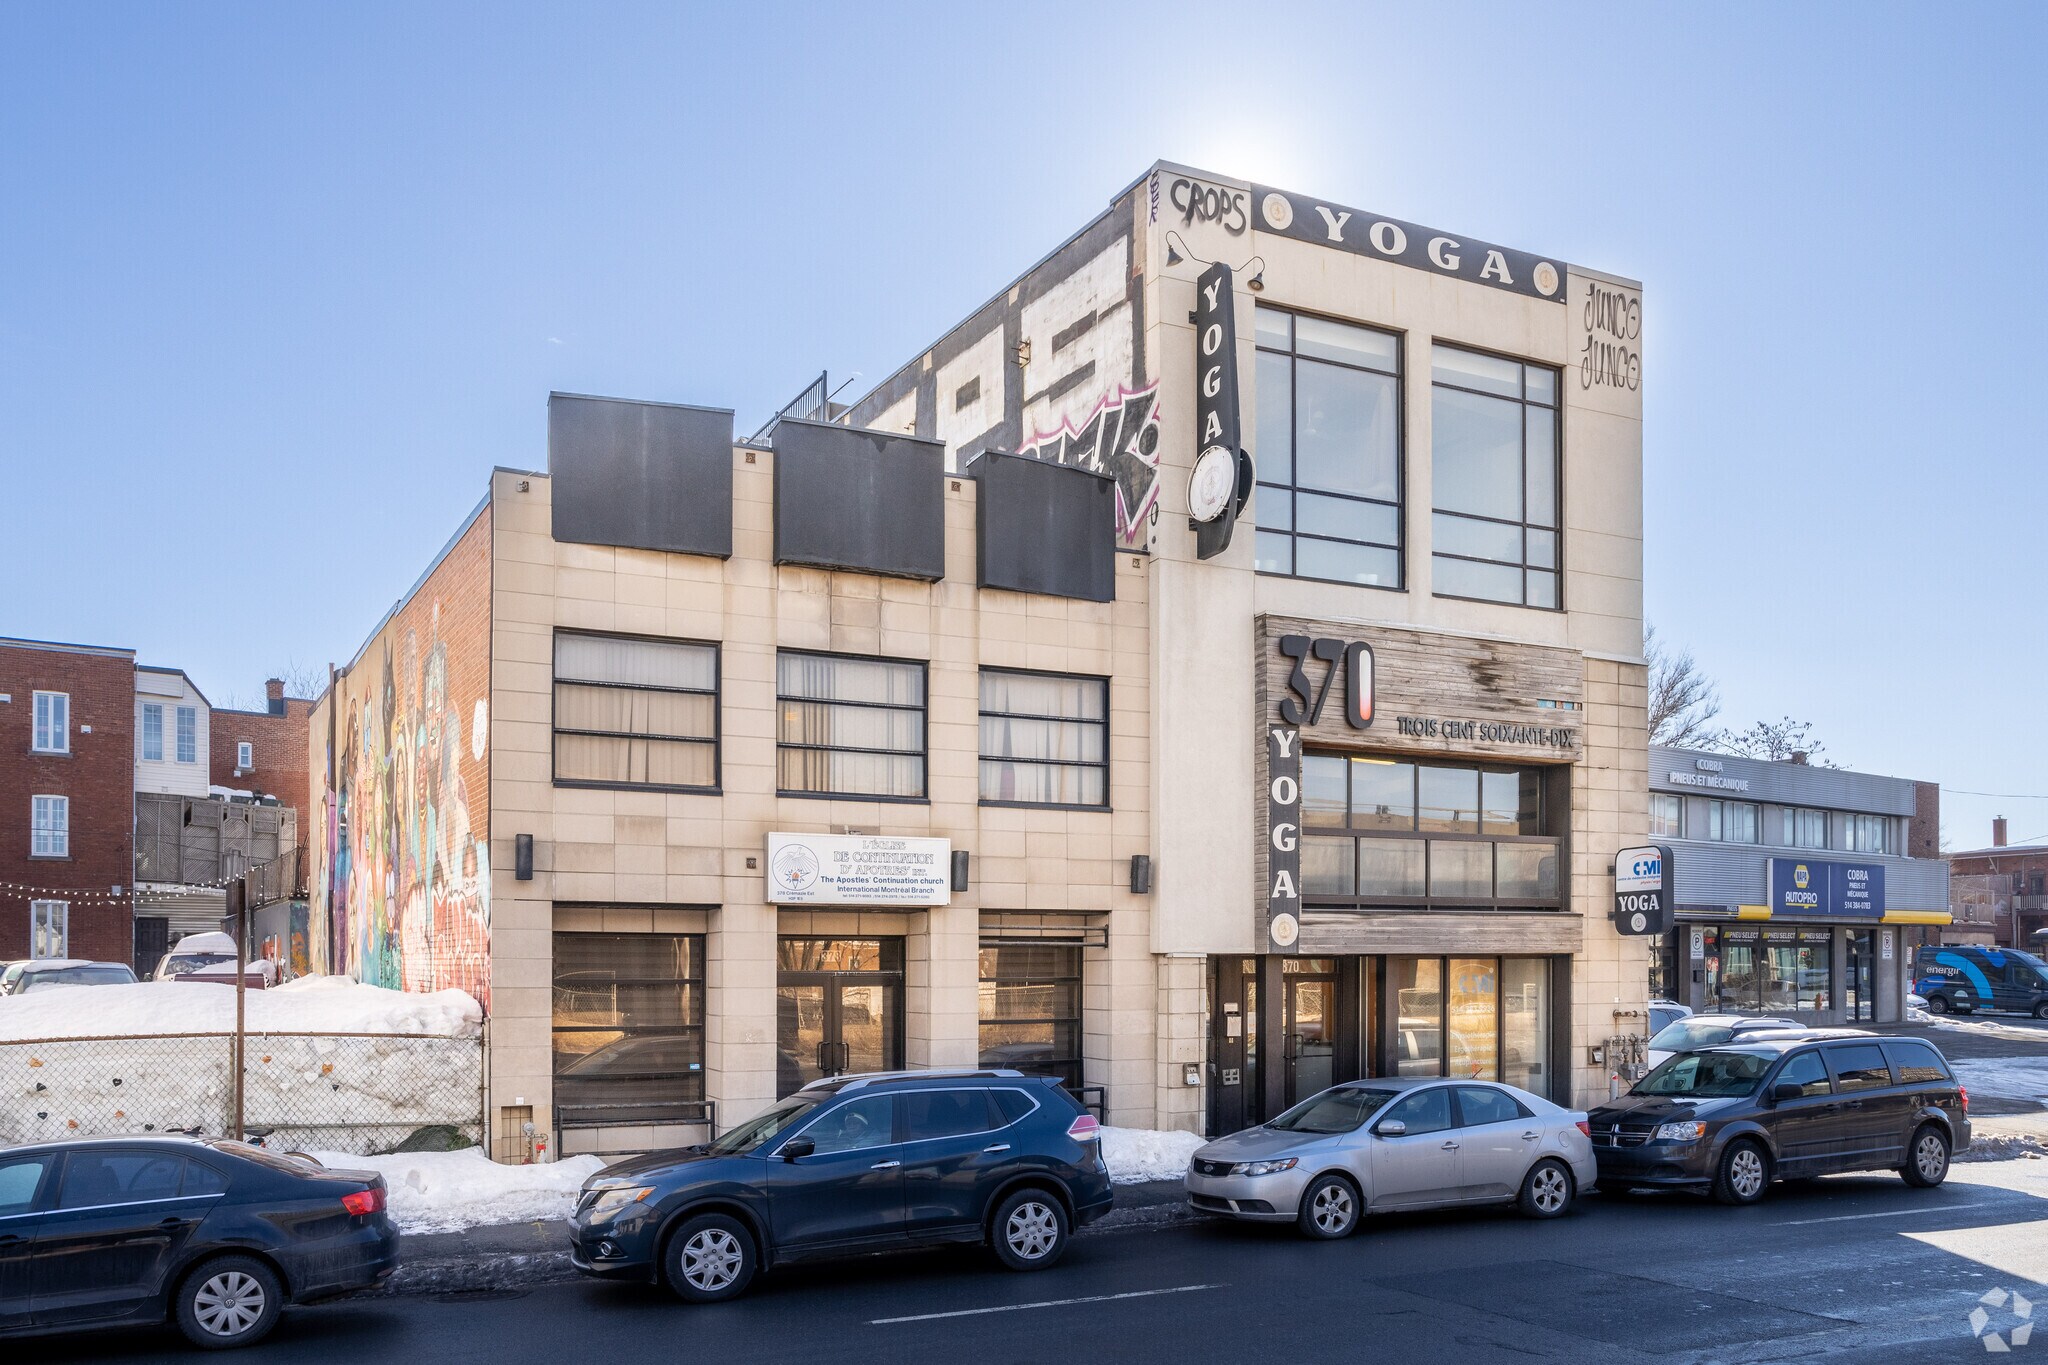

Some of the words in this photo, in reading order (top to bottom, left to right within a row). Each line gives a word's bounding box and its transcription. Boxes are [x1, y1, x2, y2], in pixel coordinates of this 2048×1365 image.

[1170, 179, 1247, 237] CROPS
[1315, 206, 1514, 285] YOGA
[1584, 283, 1641, 339] JUNCO
[1203, 277, 1223, 444] YOGA
[1581, 334, 1640, 391] JUNCO
[1280, 634, 1375, 729] 370
[1397, 716, 1438, 738] TROIS
[1441, 720, 1476, 740] CENT
[1480, 722, 1573, 748] SOIXANTE-DIX
[1696, 760, 1723, 772] COBRA
[1669, 772, 1696, 785] PNEUS
[1697, 775, 1706, 787] ET
[1707, 775, 1749, 791] MÉCANIQUE
[1271, 729, 1298, 899] YOGA
[833, 851, 849, 862] DE
[852, 852, 934, 864] CONTINUATION
[837, 876, 871, 884] Apostles'
[920, 877, 944, 885] church
[1847, 869, 1869, 881] COBRA
[1618, 894, 1660, 912] YOGA
[1785, 891, 1818, 903] AUTOPRO
[1729, 931, 1742, 939] PNEU
[1742, 931, 1759, 939] SELECT
[1780, 932, 1796, 940] SELECT
[1816, 932, 1831, 940] SELECT
